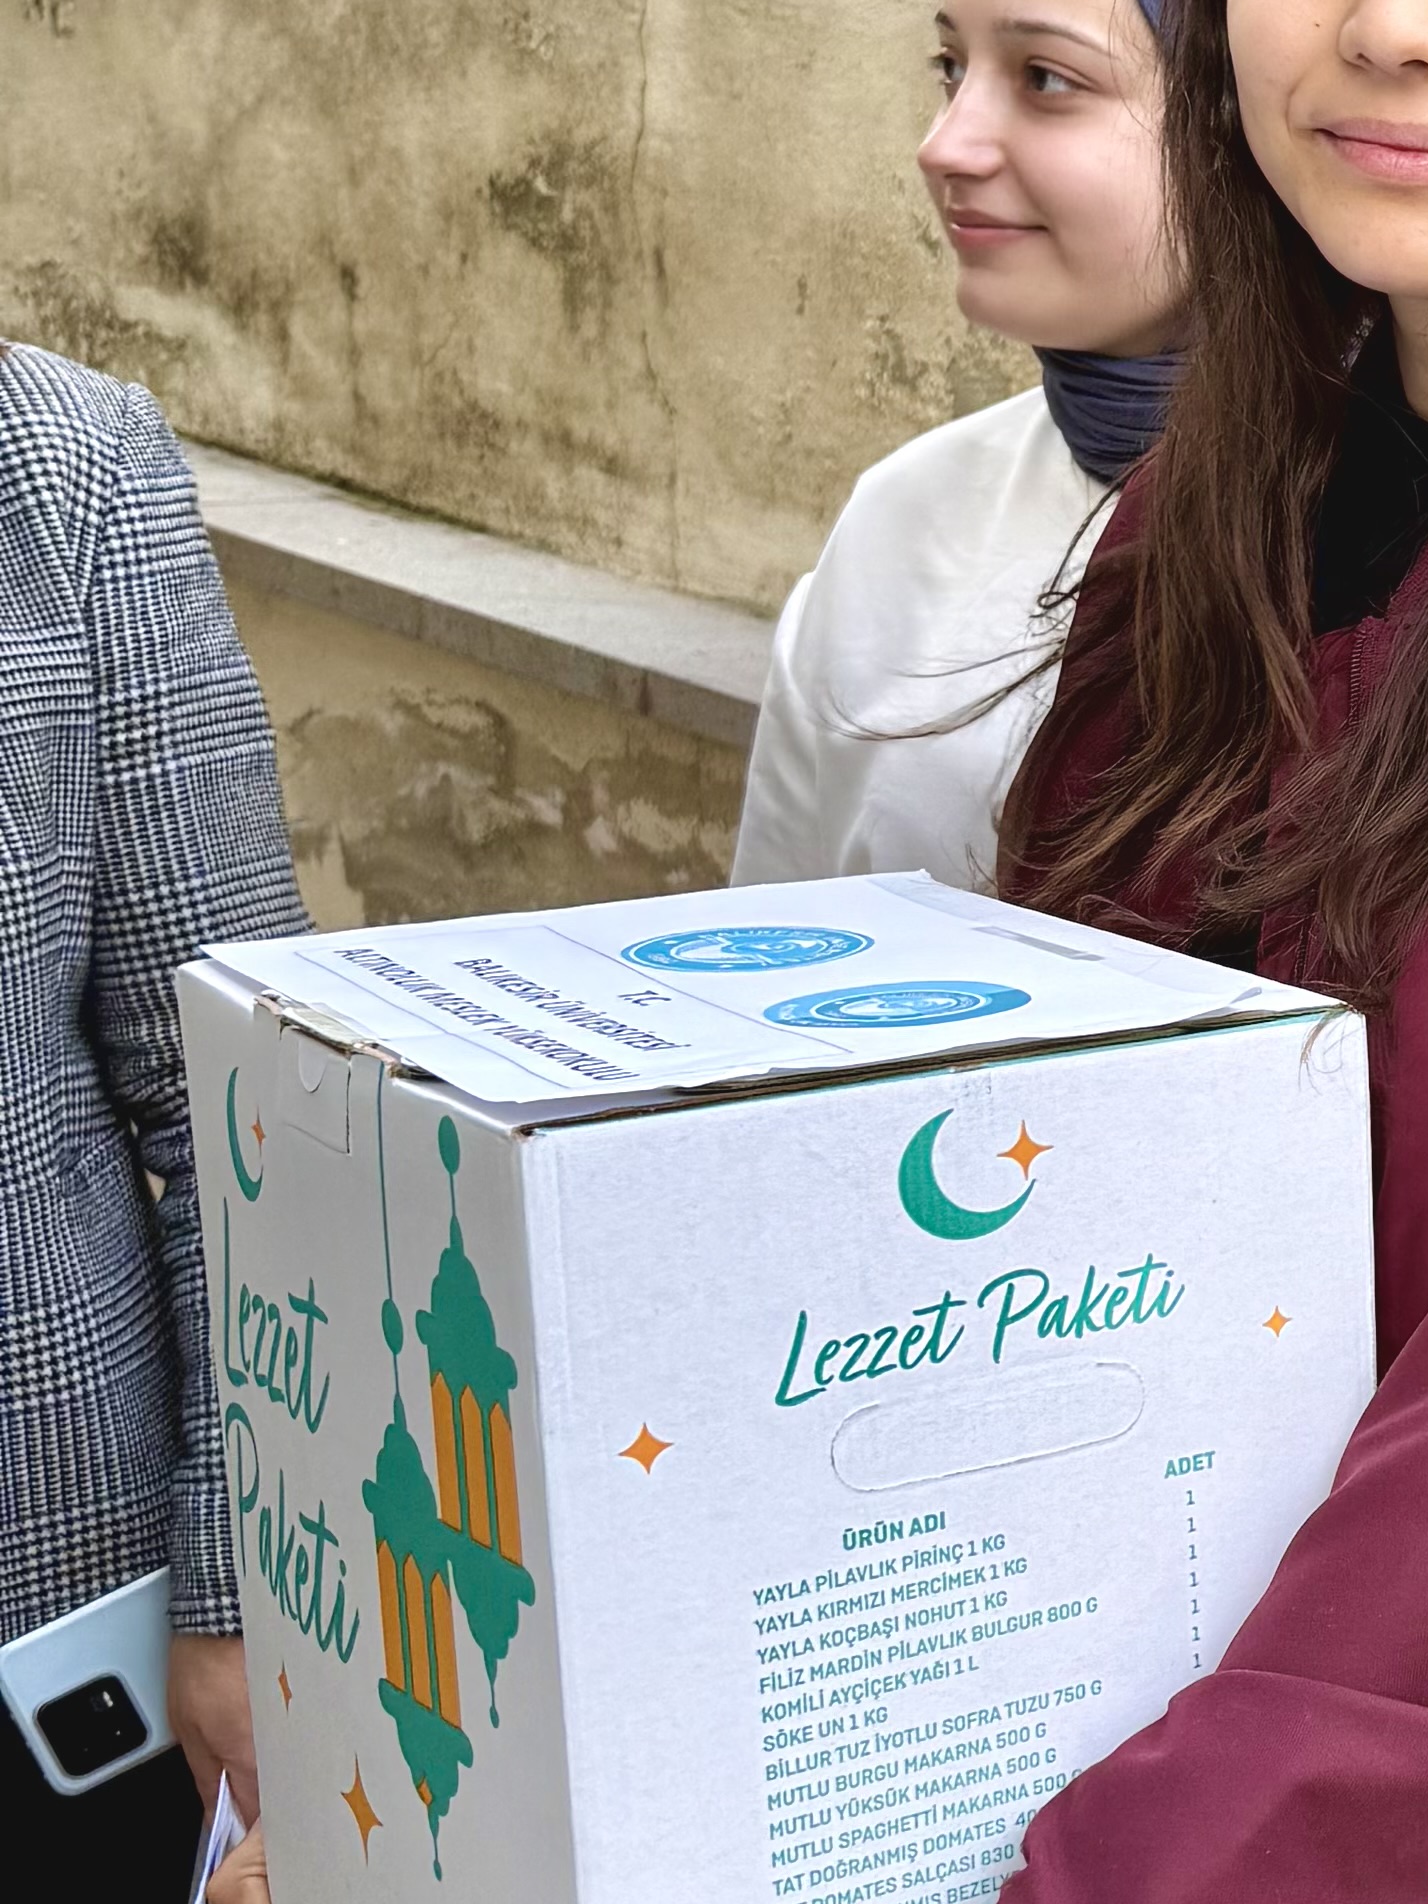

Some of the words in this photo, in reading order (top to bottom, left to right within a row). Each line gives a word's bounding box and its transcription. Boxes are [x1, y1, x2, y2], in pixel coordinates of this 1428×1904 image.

[224, 1197, 329, 1433] Lezzet
[775, 1290, 966, 1406] Lezzet
[977, 1254, 1185, 1364] Paketi
[1164, 1451, 1215, 1479] ADET
[1186, 1490, 1194, 1505] 1
[225, 1402, 359, 1663] Paketi
[842, 1520, 903, 1550] ÜRÜN
[909, 1511, 946, 1538] ADI
[1187, 1517, 1196, 1533] 1
[1189, 1544, 1197, 1560] 1
[753, 1579, 811, 1606] YAYLA
[816, 1559, 898, 1592] PİLAVLIK
[902, 1542, 963, 1573] PİRİNÇ
[968, 1541, 976, 1557] 1
[982, 1534, 1006, 1552] KG
[754, 1608, 812, 1635] YAYLA
[818, 1591, 886, 1621] KIRMIZI
[891, 1567, 986, 1604] MERCİMEK
[990, 1564, 998, 1580] 1
[1004, 1558, 1027, 1575] KG
[1189, 1571, 1198, 1587] 1
[757, 1637, 815, 1665] YAYLA
[820, 1616, 899, 1650] KOÇBAŞI
[904, 1600, 967, 1629] NOHUT
[969, 1597, 978, 1614] 1
[984, 1591, 1008, 1608] KG
[1191, 1599, 1200, 1614] 1
[1192, 1626, 1200, 1642] 1
[759, 1668, 805, 1694] FİLİZ
[810, 1648, 882, 1681] MARDİN
[888, 1629, 967, 1663] PİLAVLIK
[972, 1614, 1043, 1642] BULGUR
[1047, 1602, 1082, 1623] 800
[1087, 1597, 1098, 1614] G
[1193, 1653, 1202, 1669] 1
[762, 1690, 824, 1724] KOMİLİ
[829, 1671, 908, 1707] AYÇİÇEK
[909, 1661, 950, 1686] YAĞI
[954, 1659, 964, 1675] 1
[969, 1656, 979, 1671] L
[763, 1724, 813, 1753] SÖKE
[818, 1718, 844, 1738] UN
[850, 1714, 858, 1730] 1
[864, 1707, 888, 1724] KG
[766, 1750, 832, 1781] BİLLUR
[835, 1740, 871, 1764] TUZ
[875, 1722, 938, 1754] İYOTLU
[942, 1706, 1001, 1736] SOFRA
[1004, 1694, 1049, 1719] TUZU
[1053, 1685, 1086, 1706] 750
[1091, 1680, 1102, 1696] G
[767, 1782, 829, 1810] MUTLU
[835, 1763, 899, 1792] BURGU
[904, 1737, 992, 1774] MAKARNA
[996, 1727, 1031, 1748] 500
[1035, 1723, 1047, 1738] G
[769, 1809, 832, 1840] MUTLU
[836, 1787, 911, 1820] YÜKSÜK
[914, 1764, 1002, 1800] MAKARNA
[1007, 1752, 1039, 1774] 500
[1045, 1748, 1057, 1764] G
[771, 1837, 834, 1868] MUTLU
[838, 1805, 938, 1848] SPAGHETTİ
[942, 1778, 1029, 1820] MAKARNA
[1033, 1773, 1066, 1795] 500
[772, 1874, 805, 1896] TAT
[810, 1843, 918, 1888] DOĞRANMIŞ
[922, 1818, 1006, 1855] DOMATES
[902, 1856, 976, 1888] SALÇASI
[981, 1844, 1014, 1866] 830
